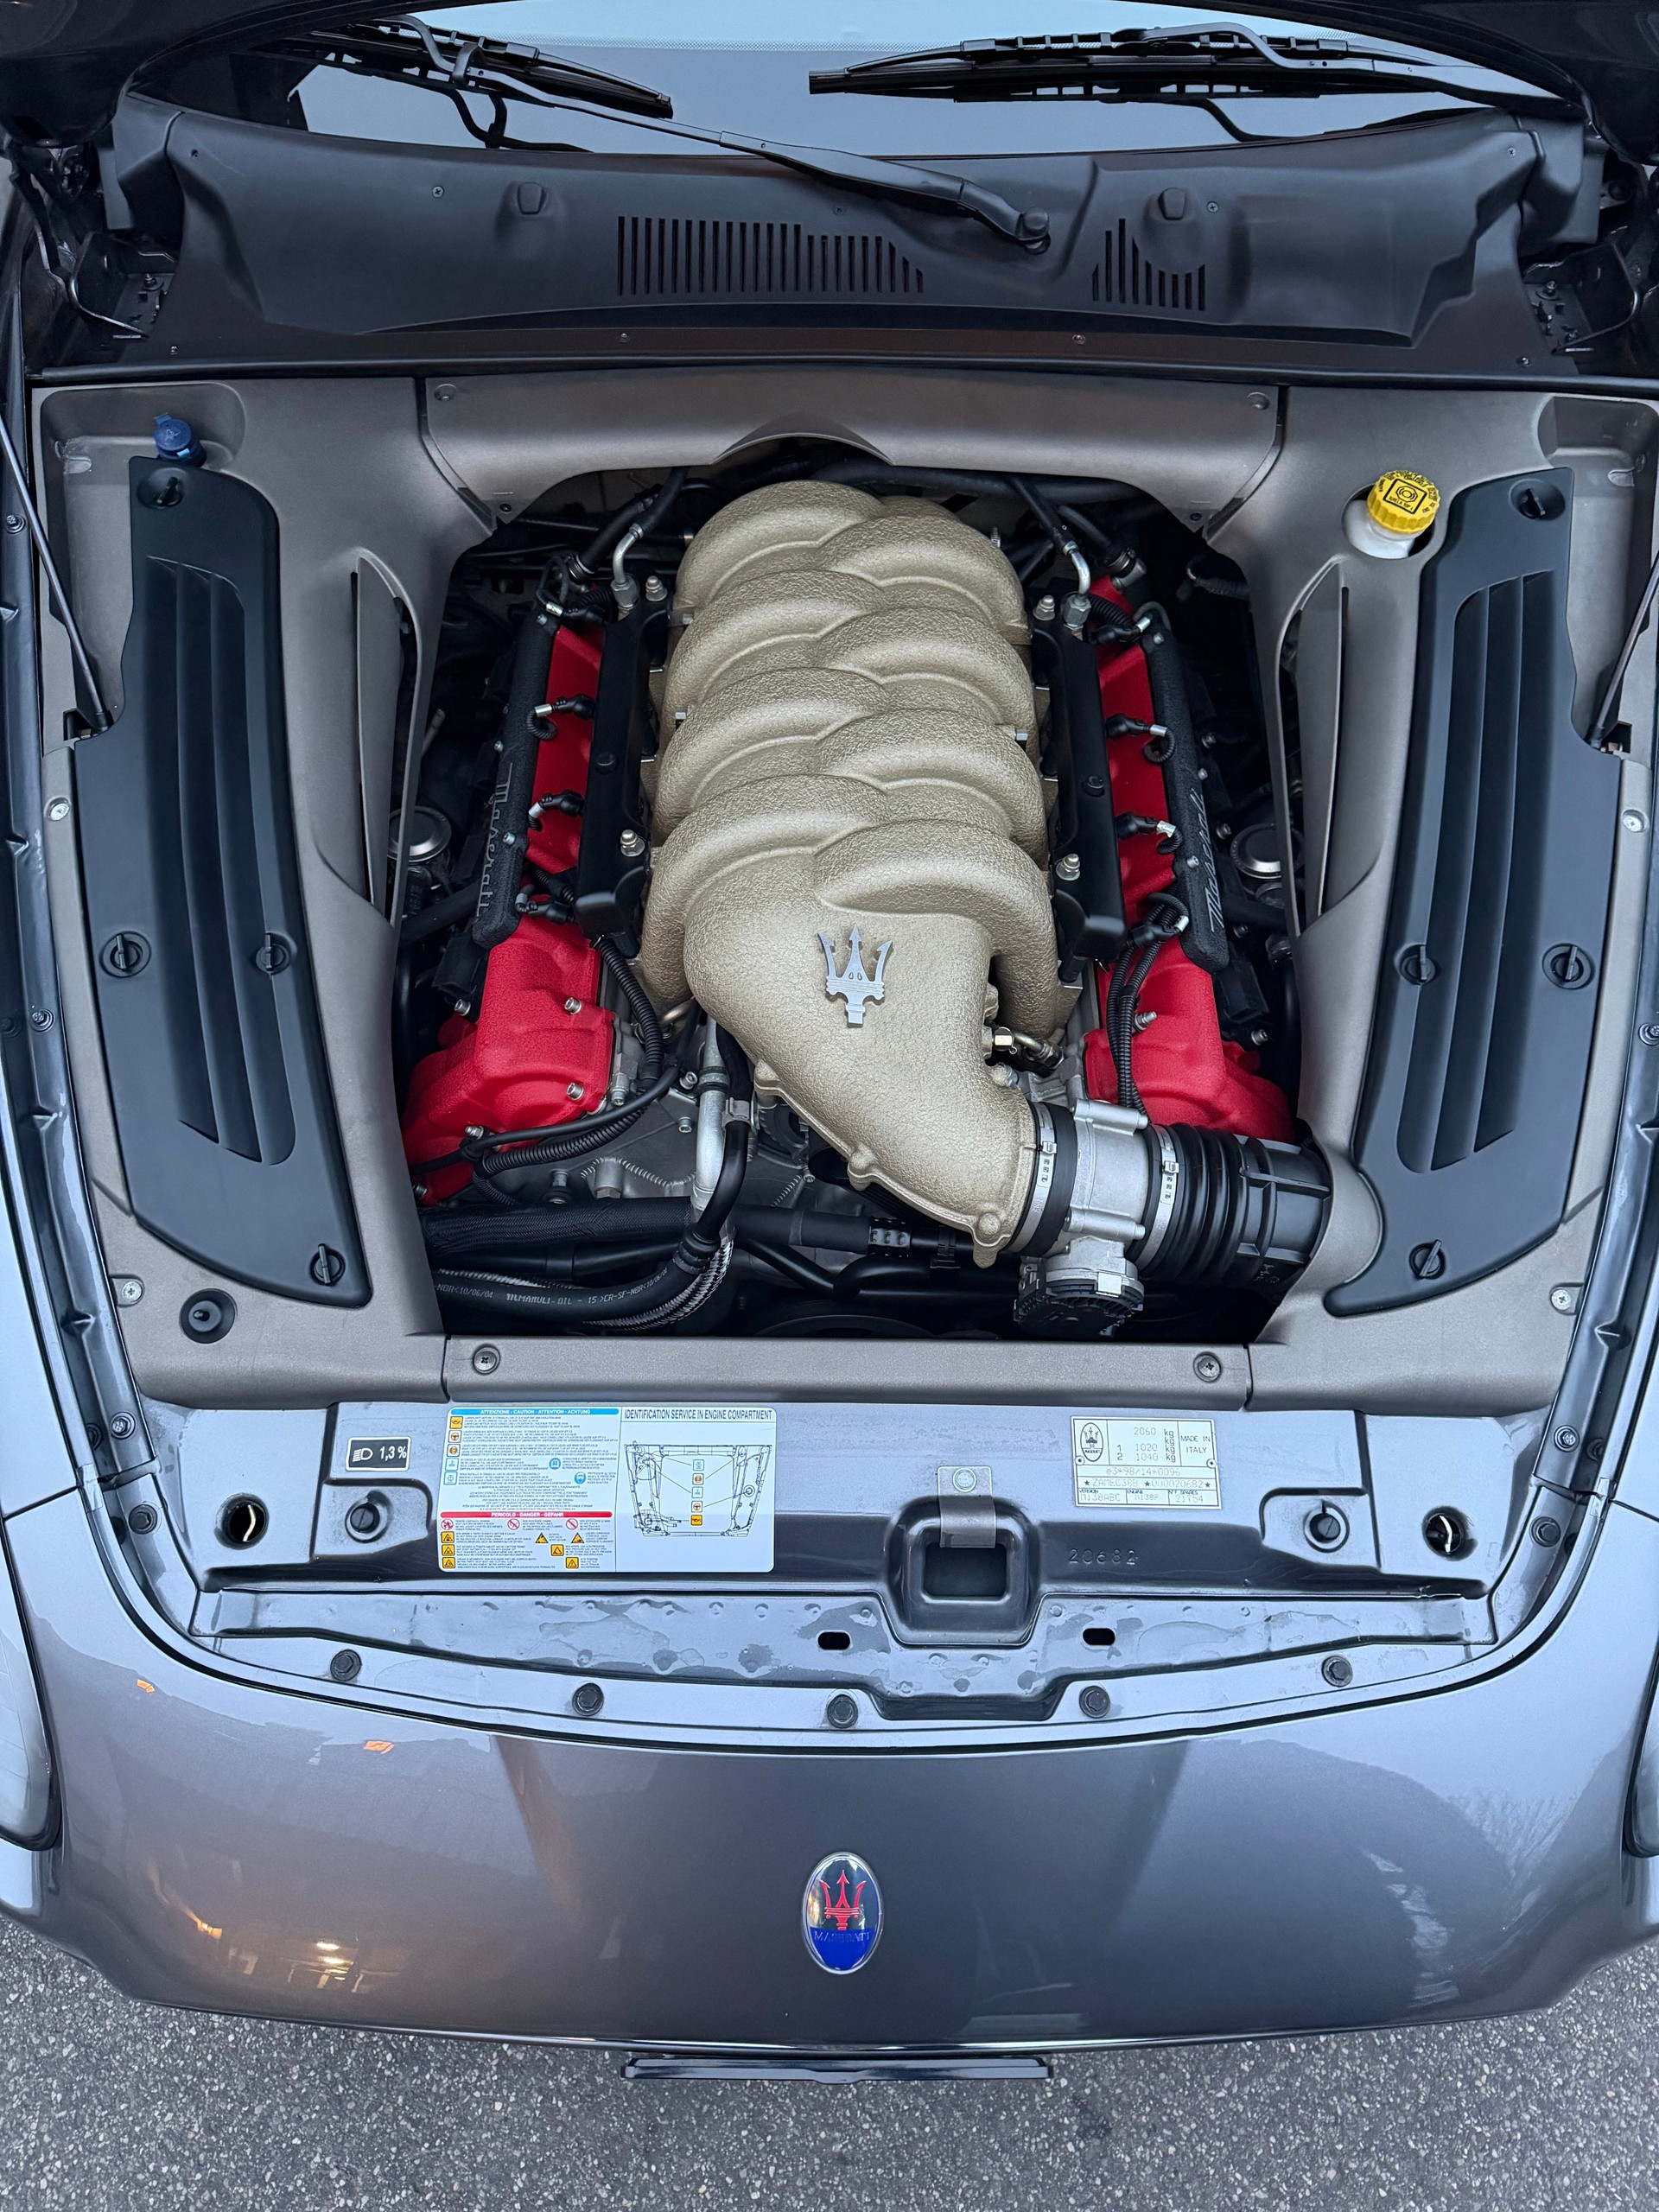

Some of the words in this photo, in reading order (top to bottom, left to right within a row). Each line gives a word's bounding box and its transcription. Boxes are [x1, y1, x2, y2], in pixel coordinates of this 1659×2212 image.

[1190, 787, 1224, 932] Maserati
[624, 1409, 670, 1420] IDENTIFICATION
[671, 1409, 696, 1420] SERVICE
[696, 1409, 703, 1419] IN
[704, 1409, 727, 1420] ENGINE
[728, 1409, 772, 1420] COMPARTMENT
[1134, 1427, 1156, 1436] 2060
[1164, 1428, 1174, 1438] kg
[1165, 1437, 1175, 1446] kg
[379, 1446, 396, 1461] 1,3
[397, 1446, 407, 1459] %
[1135, 1443, 1158, 1452] 1020
[1166, 1446, 1176, 1454] kg
[1117, 1452, 1123, 1461] 2
[1136, 1452, 1159, 1461] 1040
[1166, 1453, 1176, 1463] kg
[1069, 1548, 1136, 1566] 20682
[814, 1930, 870, 1942] MAATI
